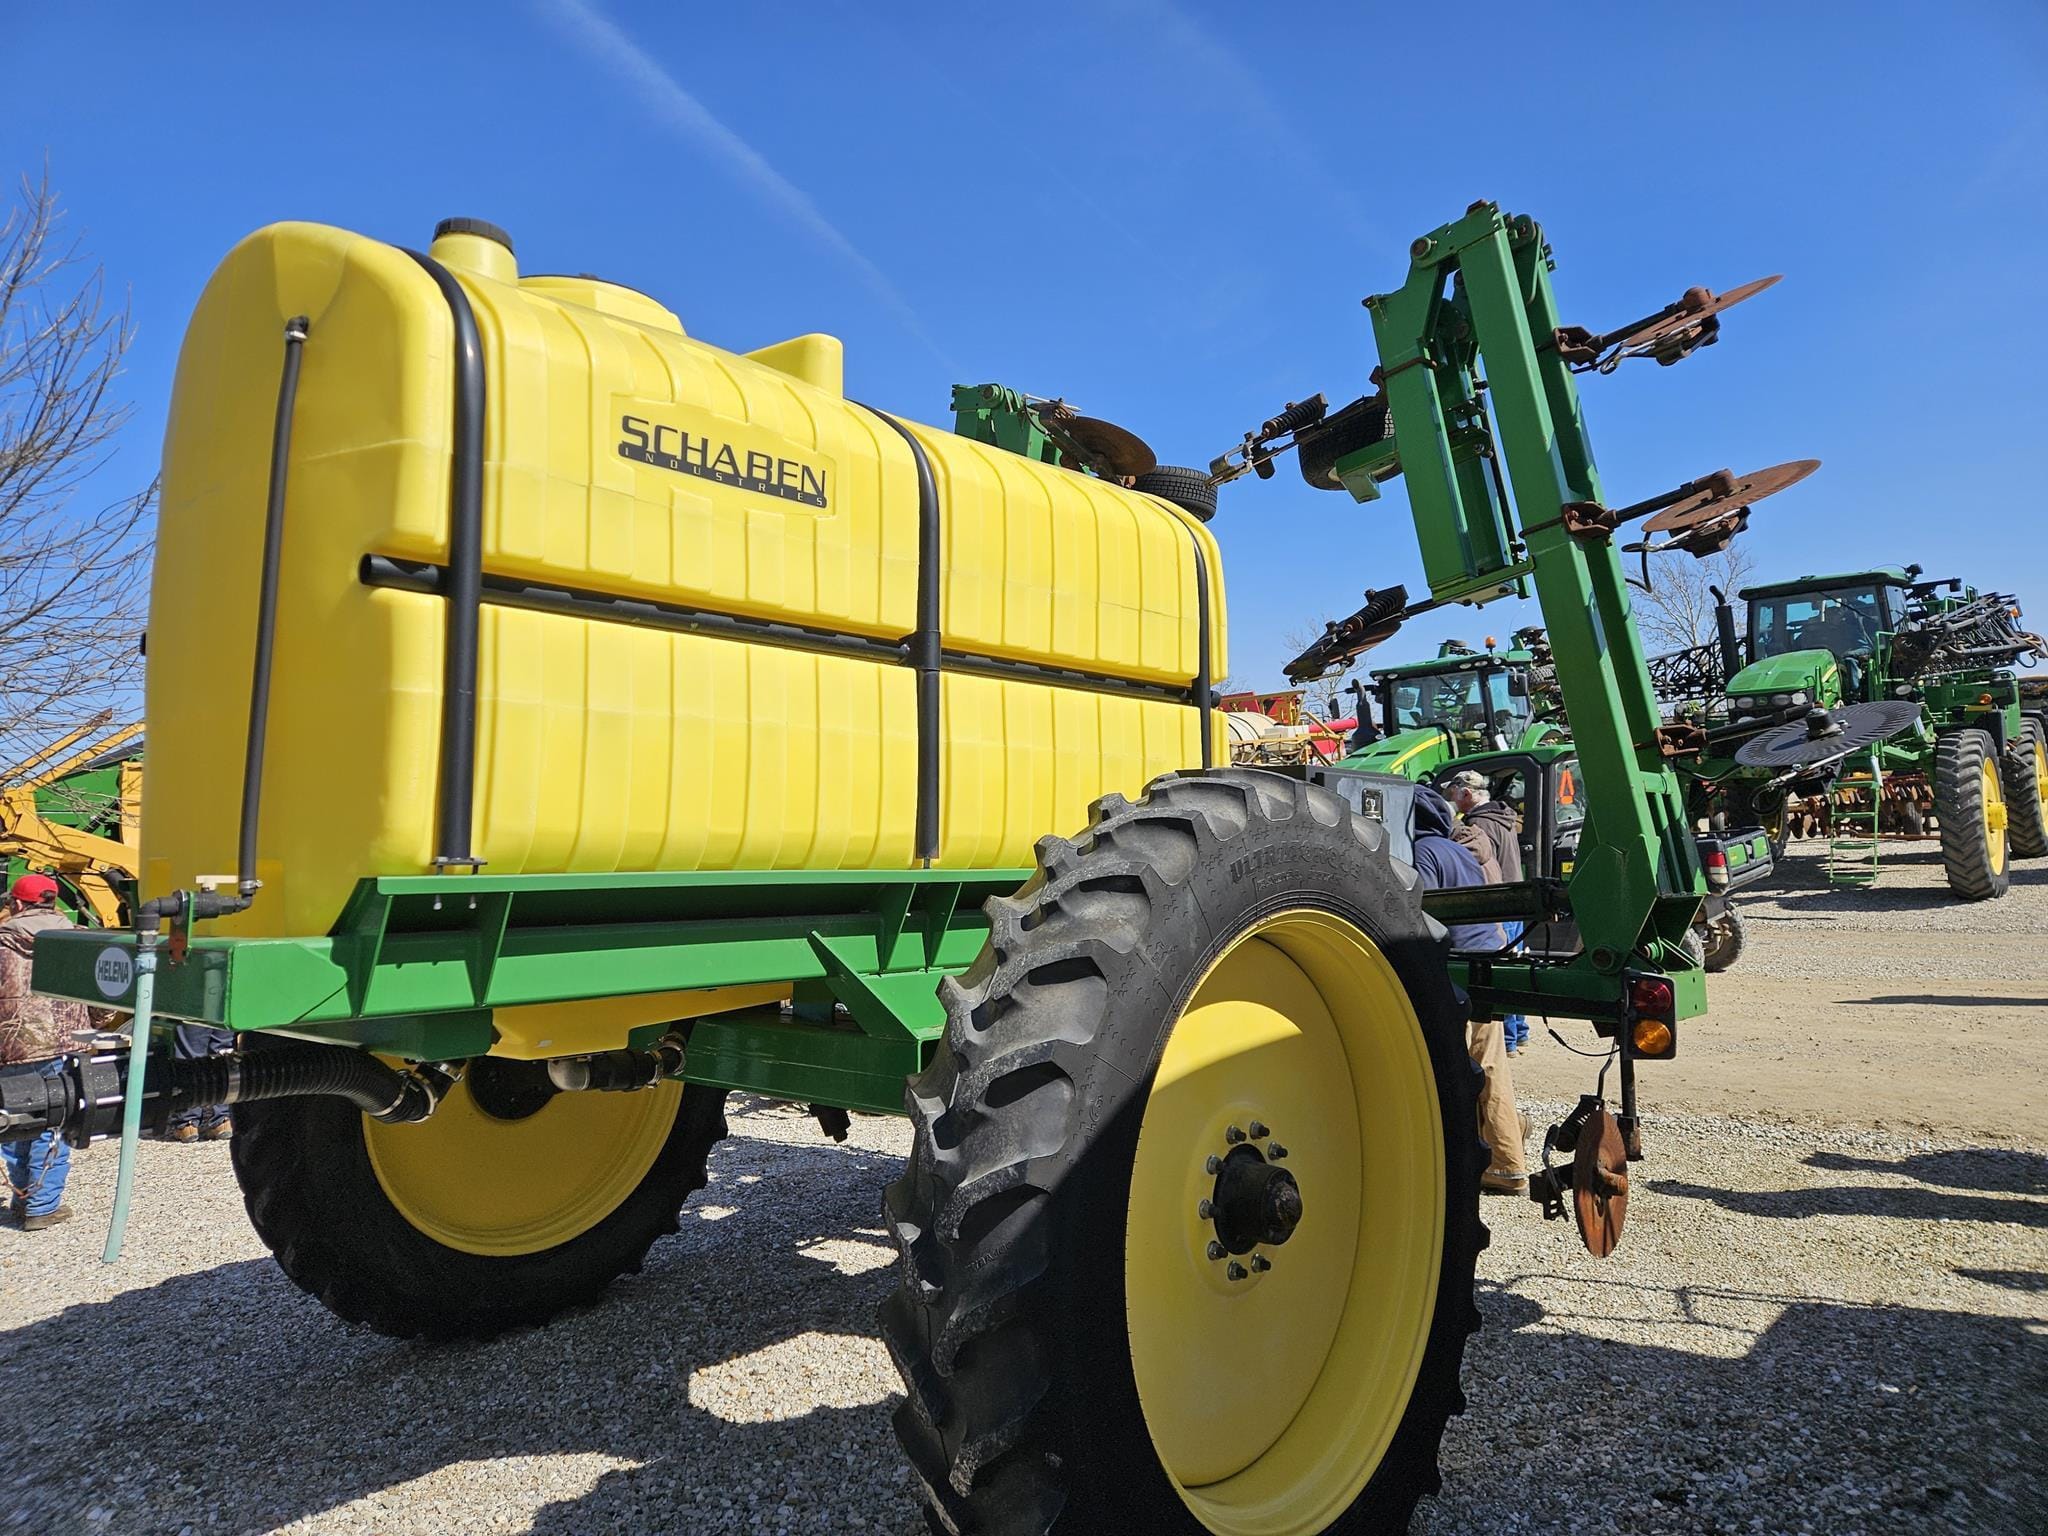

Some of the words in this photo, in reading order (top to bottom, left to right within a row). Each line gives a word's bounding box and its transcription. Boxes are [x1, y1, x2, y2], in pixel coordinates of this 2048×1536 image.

[621, 415, 826, 497] SCHABEN
[624, 447, 824, 507] INDUSTRIES
[97, 959, 130, 984] HELENA
